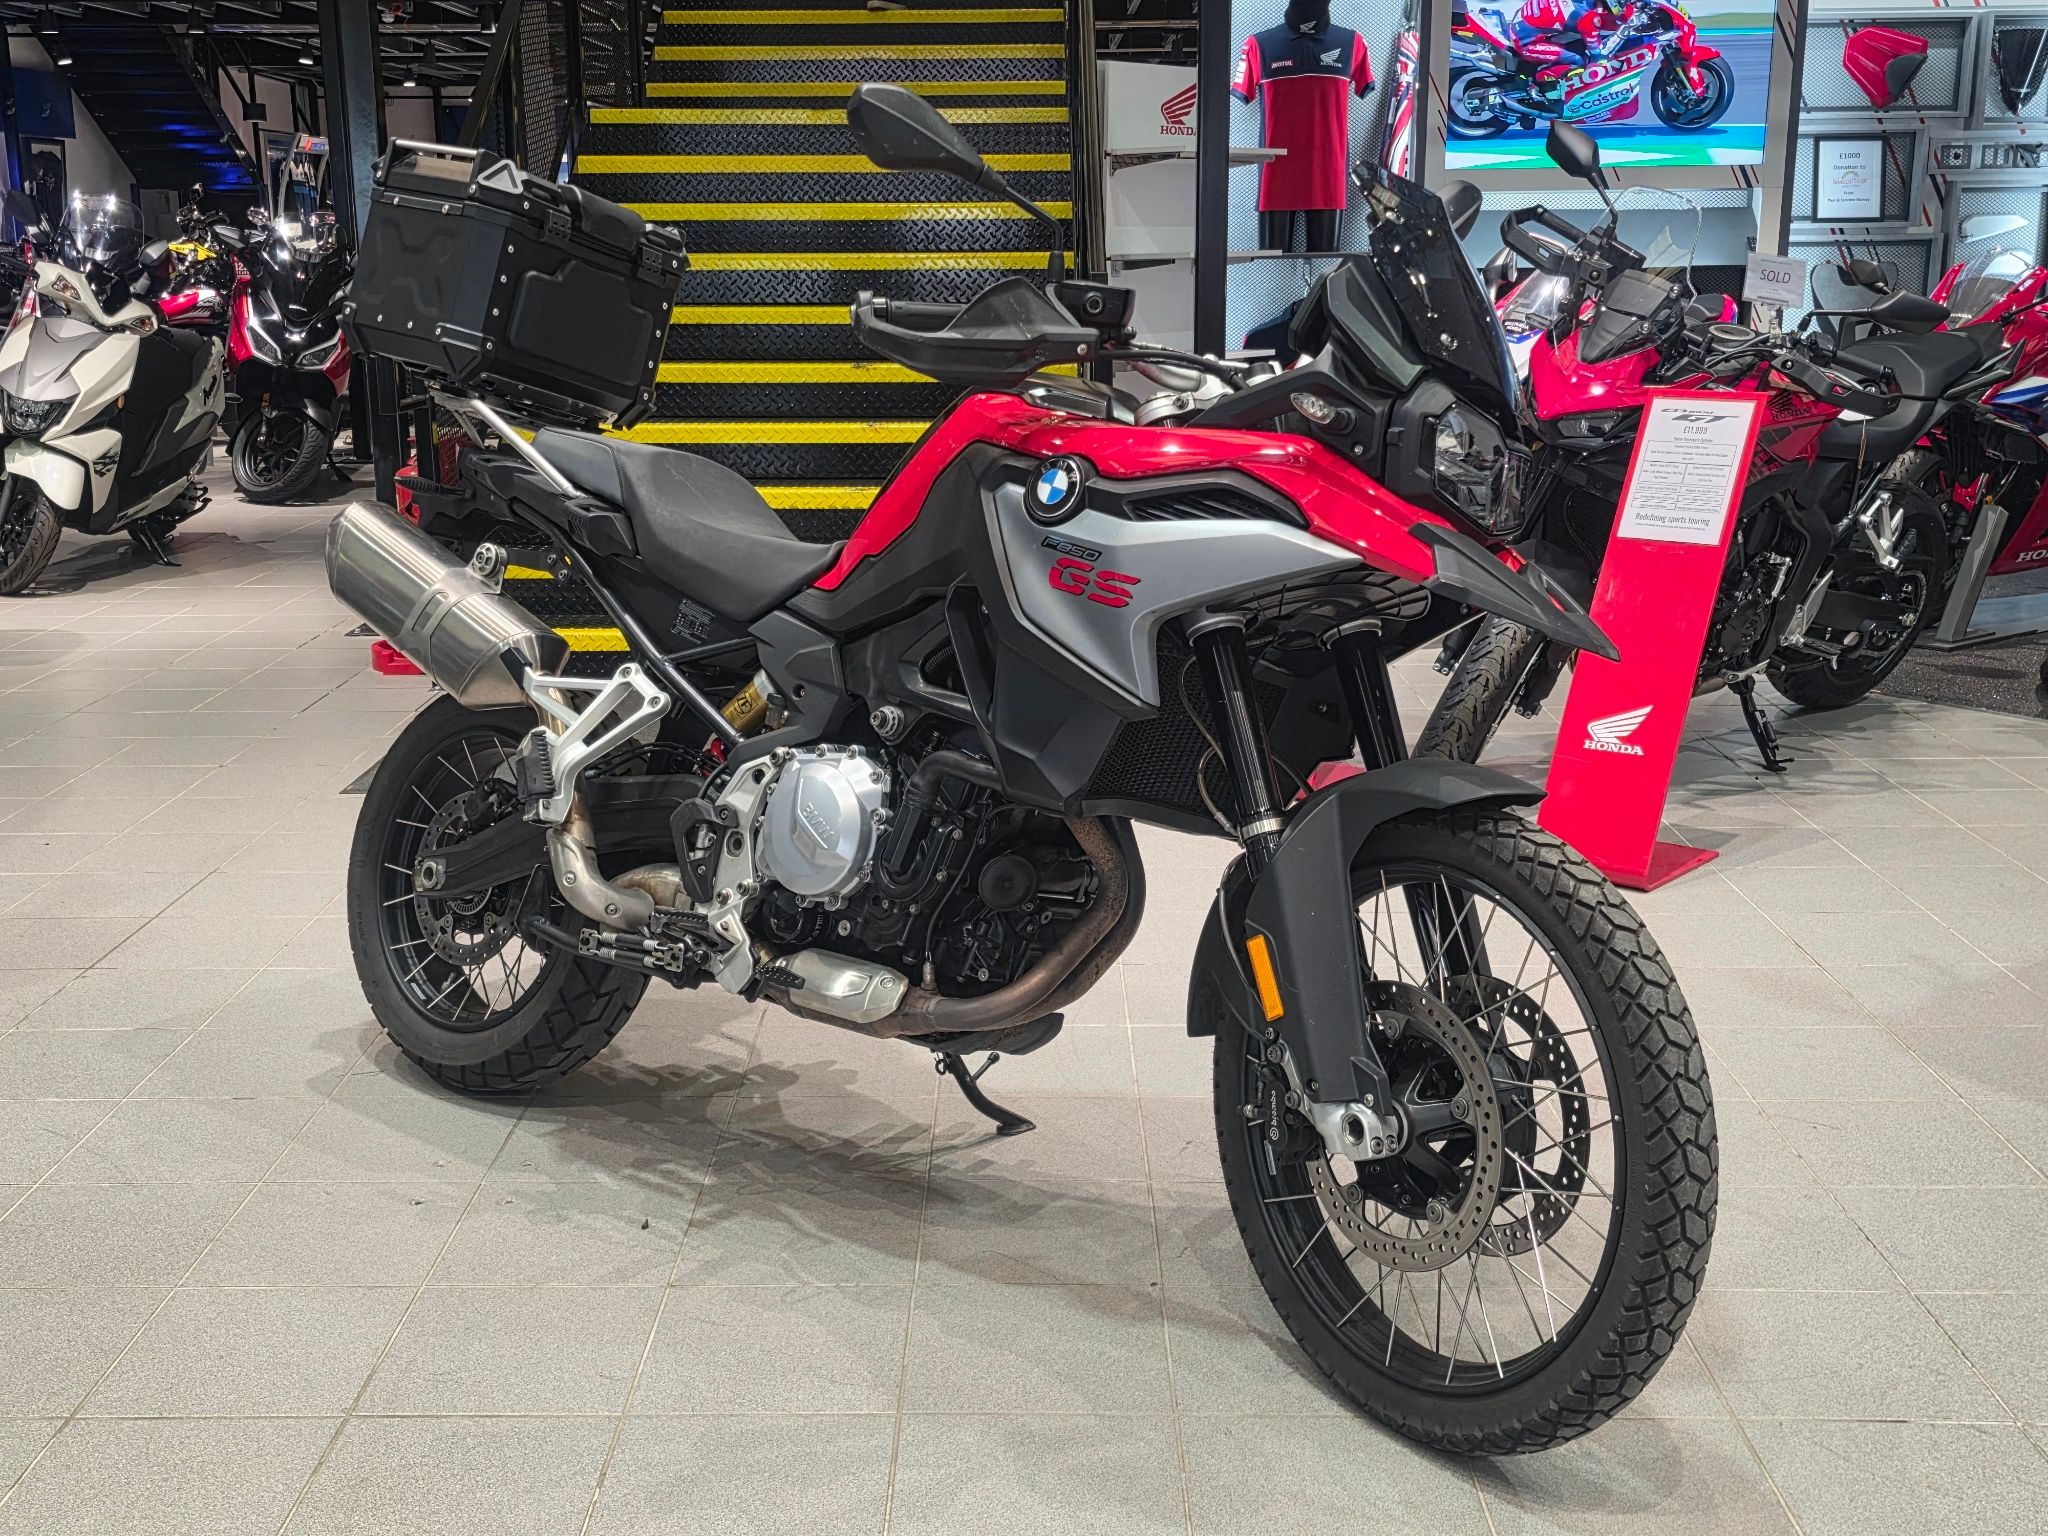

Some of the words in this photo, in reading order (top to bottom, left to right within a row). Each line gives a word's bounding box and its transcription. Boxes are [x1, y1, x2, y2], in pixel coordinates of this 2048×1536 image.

[1271, 60, 1293, 69] MOTUL
[1579, 83, 1634, 110] Castrol
[1759, 269, 1791, 284] SOLD
[1671, 414, 1738, 424] GT
[1683, 426, 1708, 435] £11,999
[1635, 512, 1667, 523] Redefining
[1667, 515, 1686, 524] sports
[1688, 517, 1711, 526] touring
[2016, 549, 2048, 562] HO
[1049, 557, 1141, 608] GS
[1583, 739, 1645, 756] HONDA
[803, 801, 834, 838] BMW
